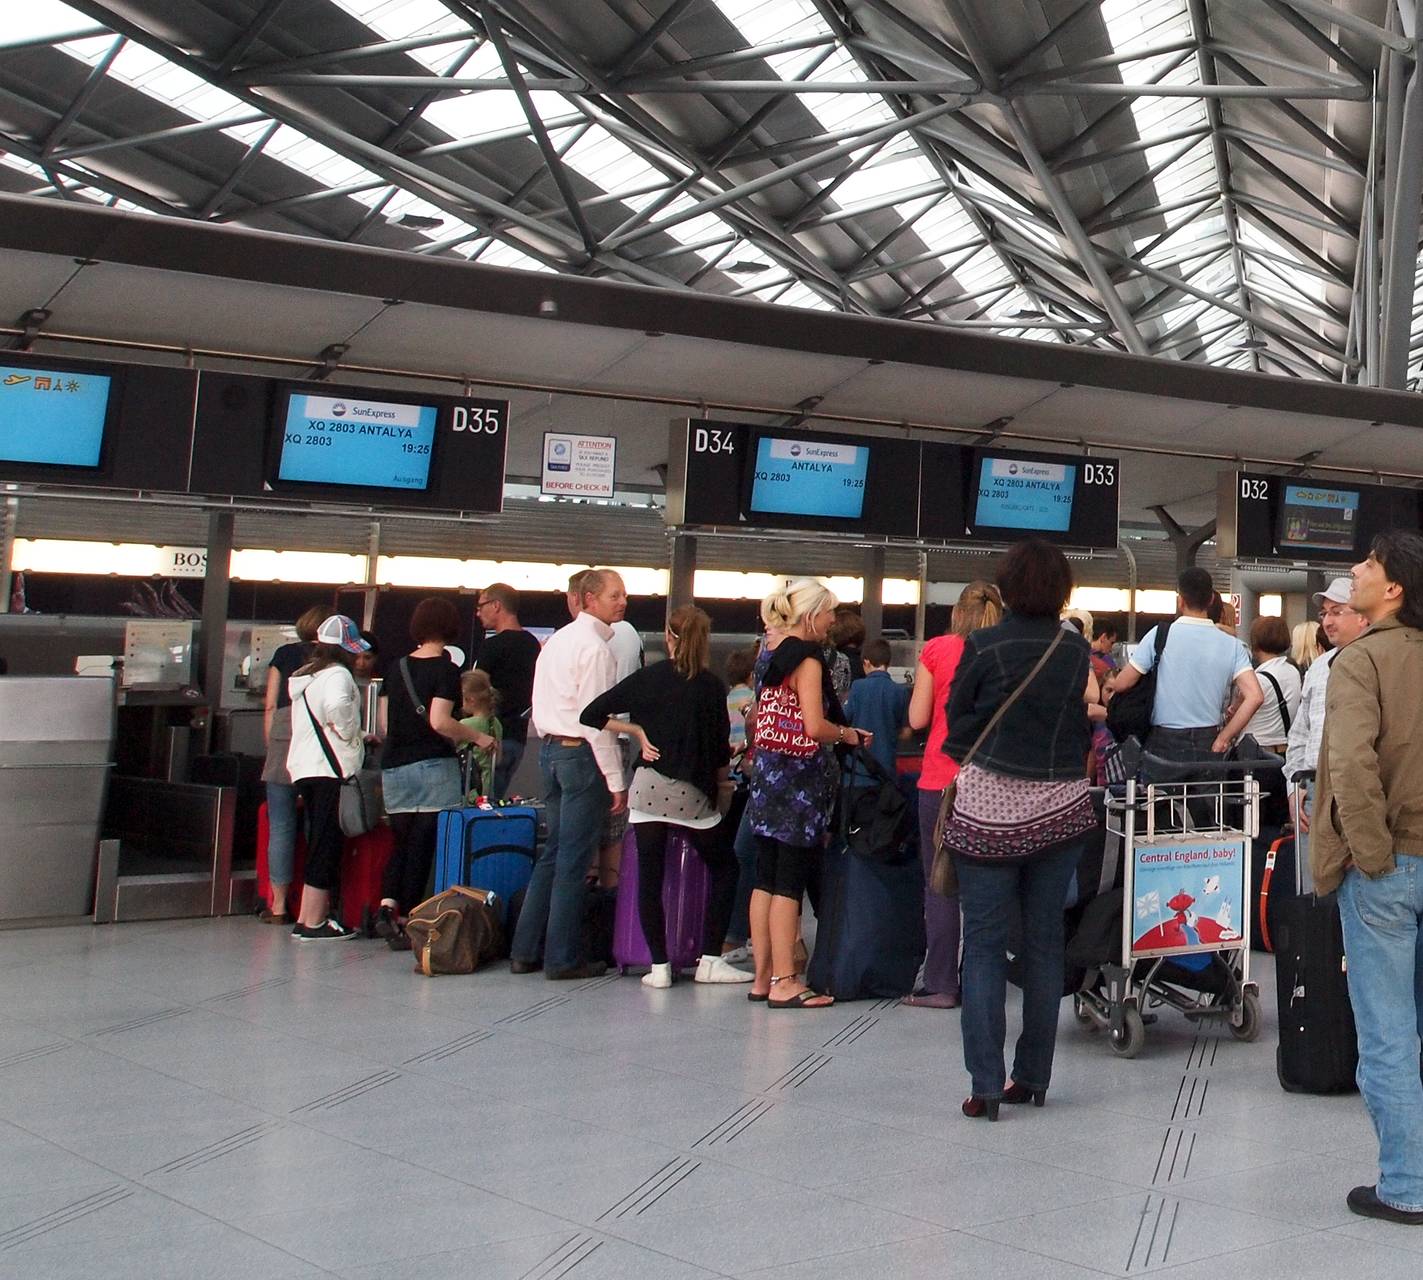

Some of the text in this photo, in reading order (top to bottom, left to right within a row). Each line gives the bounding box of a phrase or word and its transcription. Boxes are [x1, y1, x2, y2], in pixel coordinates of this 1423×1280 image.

[353, 406, 395, 419] SunExpress
[453, 406, 499, 435] D35
[308, 420, 413, 439] XQ 2803 ANTALYA
[285, 433, 302, 444] XQ
[306, 435, 332, 447] 2803
[577, 441, 612, 449] ATTENTION
[695, 428, 735, 455] D34
[806, 447, 839, 458] SunExpress
[791, 461, 833, 473] ANTALYA
[1084, 463, 1115, 485] D33
[546, 481, 574, 490] BEFORE
[755, 471, 864, 488] XQ 2803 19:25
[993, 478, 1005, 487] XQ
[1026, 481, 1061, 491] ANTALYA
[1241, 479, 1269, 500] D32
[760, 727, 789, 743] KÖLN
[1140, 848, 1235, 863] Central England, baby!
